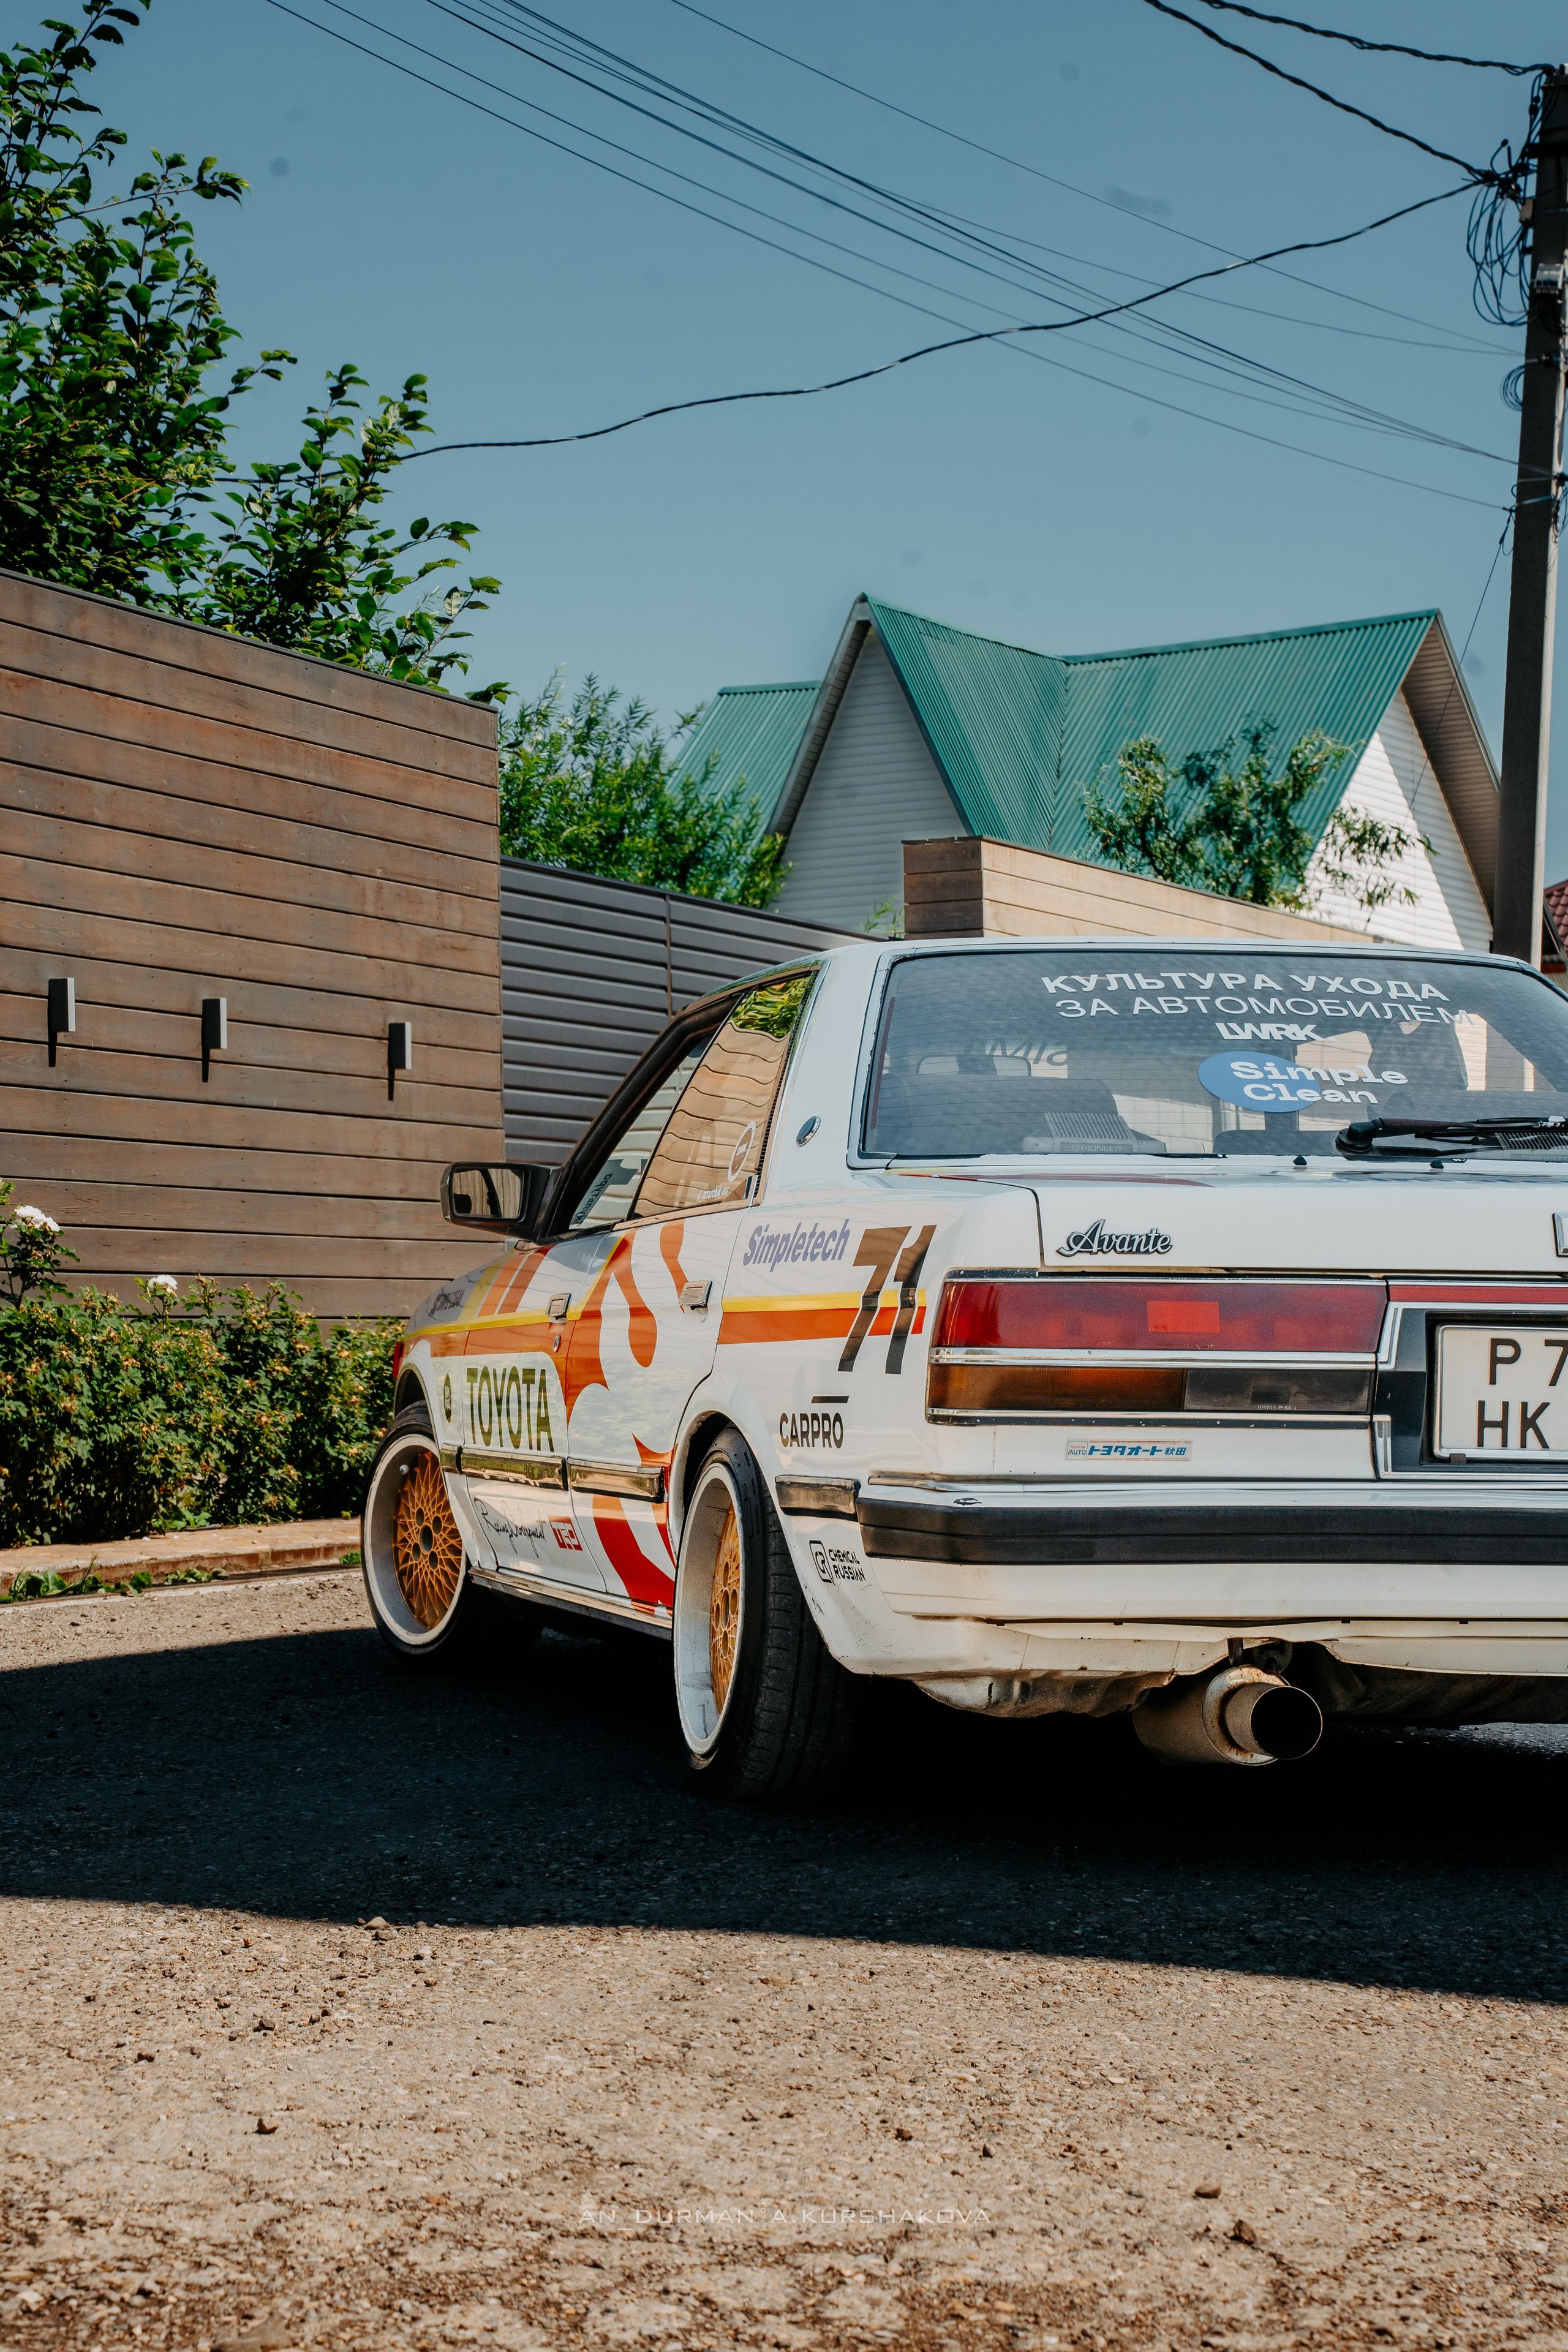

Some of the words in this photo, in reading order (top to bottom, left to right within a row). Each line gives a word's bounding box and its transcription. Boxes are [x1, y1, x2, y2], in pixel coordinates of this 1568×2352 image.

[1041, 973, 1283, 993] КУЛЬТУРА
[1289, 975, 1450, 1001] УХОДА
[1055, 998, 1119, 1018] ЗА
[1133, 997, 1475, 1027] АВТОМОБИЛЕМ
[1230, 1061, 1409, 1086] Simple
[1243, 1083, 1378, 1104] Clean
[743, 1218, 850, 1273] Simpletech
[1056, 1219, 1173, 1257] Avante
[837, 1224, 937, 1374] 71
[466, 1366, 554, 1453] TOYOTA
[779, 1412, 843, 1449] CARPRO
[1088, 1445, 1163, 1456] トヨタオート
[1164, 1447, 1187, 1456] 秋田
[828, 1548, 861, 1565] CHEMICAL
[832, 1564, 866, 1582] RUSSIAN
